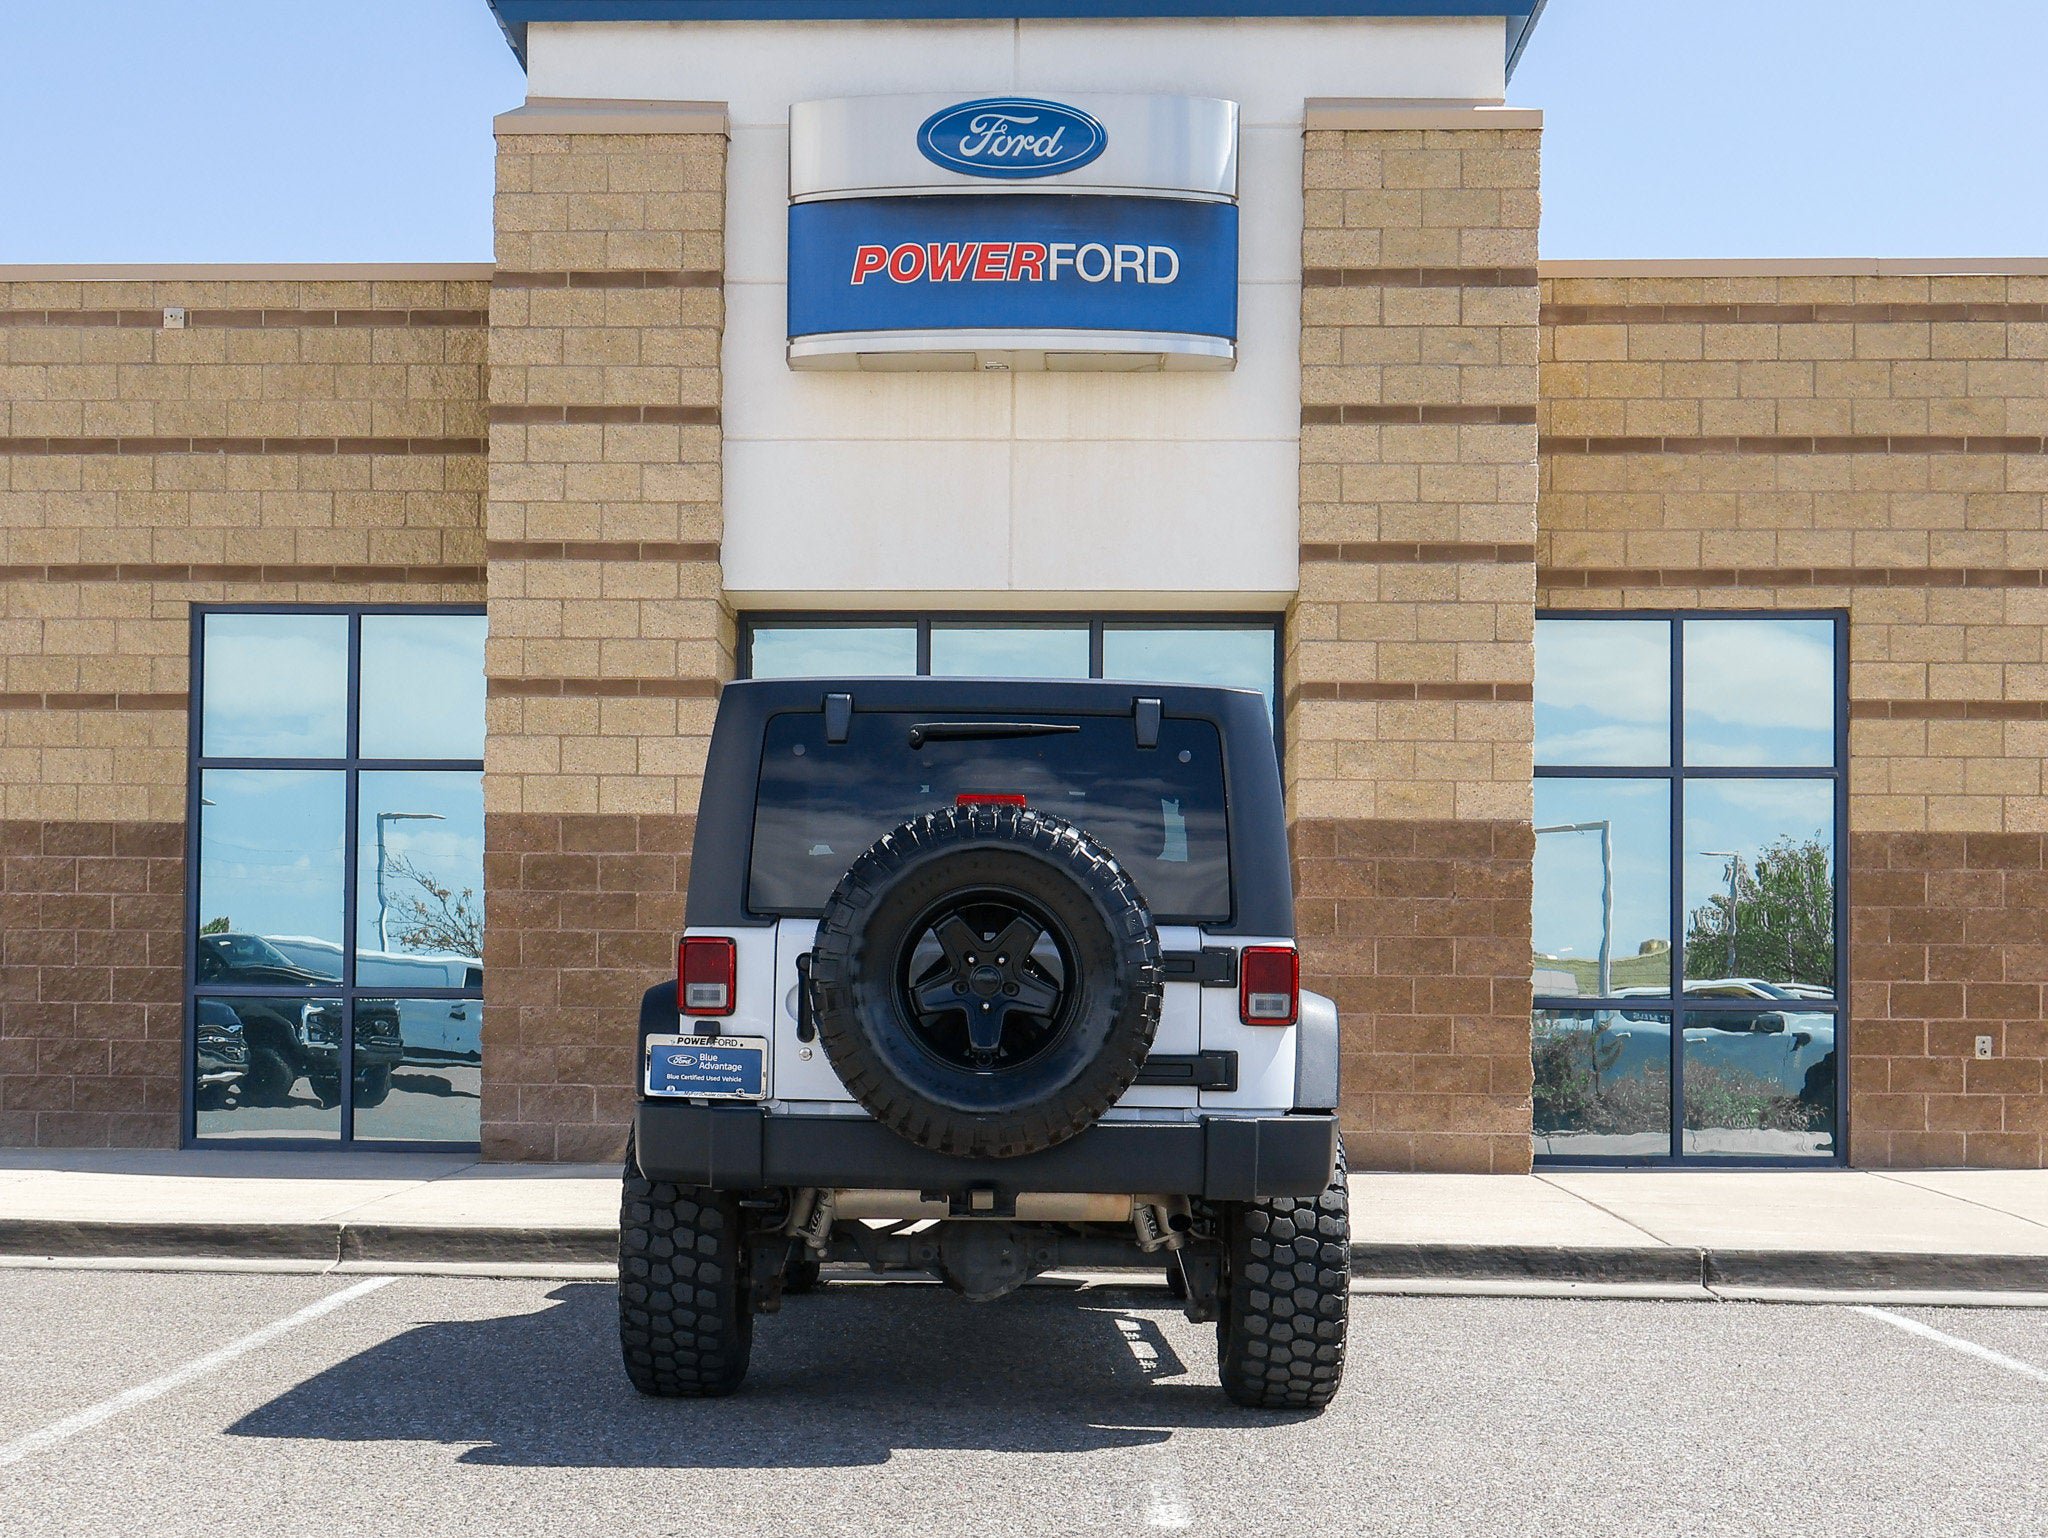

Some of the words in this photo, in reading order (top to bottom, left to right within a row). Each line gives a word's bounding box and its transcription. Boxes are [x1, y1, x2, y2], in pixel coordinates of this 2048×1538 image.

[959, 113, 1065, 158] Ford
[672, 1056, 692, 1065] Ford
[699, 1053, 718, 1061] Blue
[699, 1062, 742, 1072] Advantage
